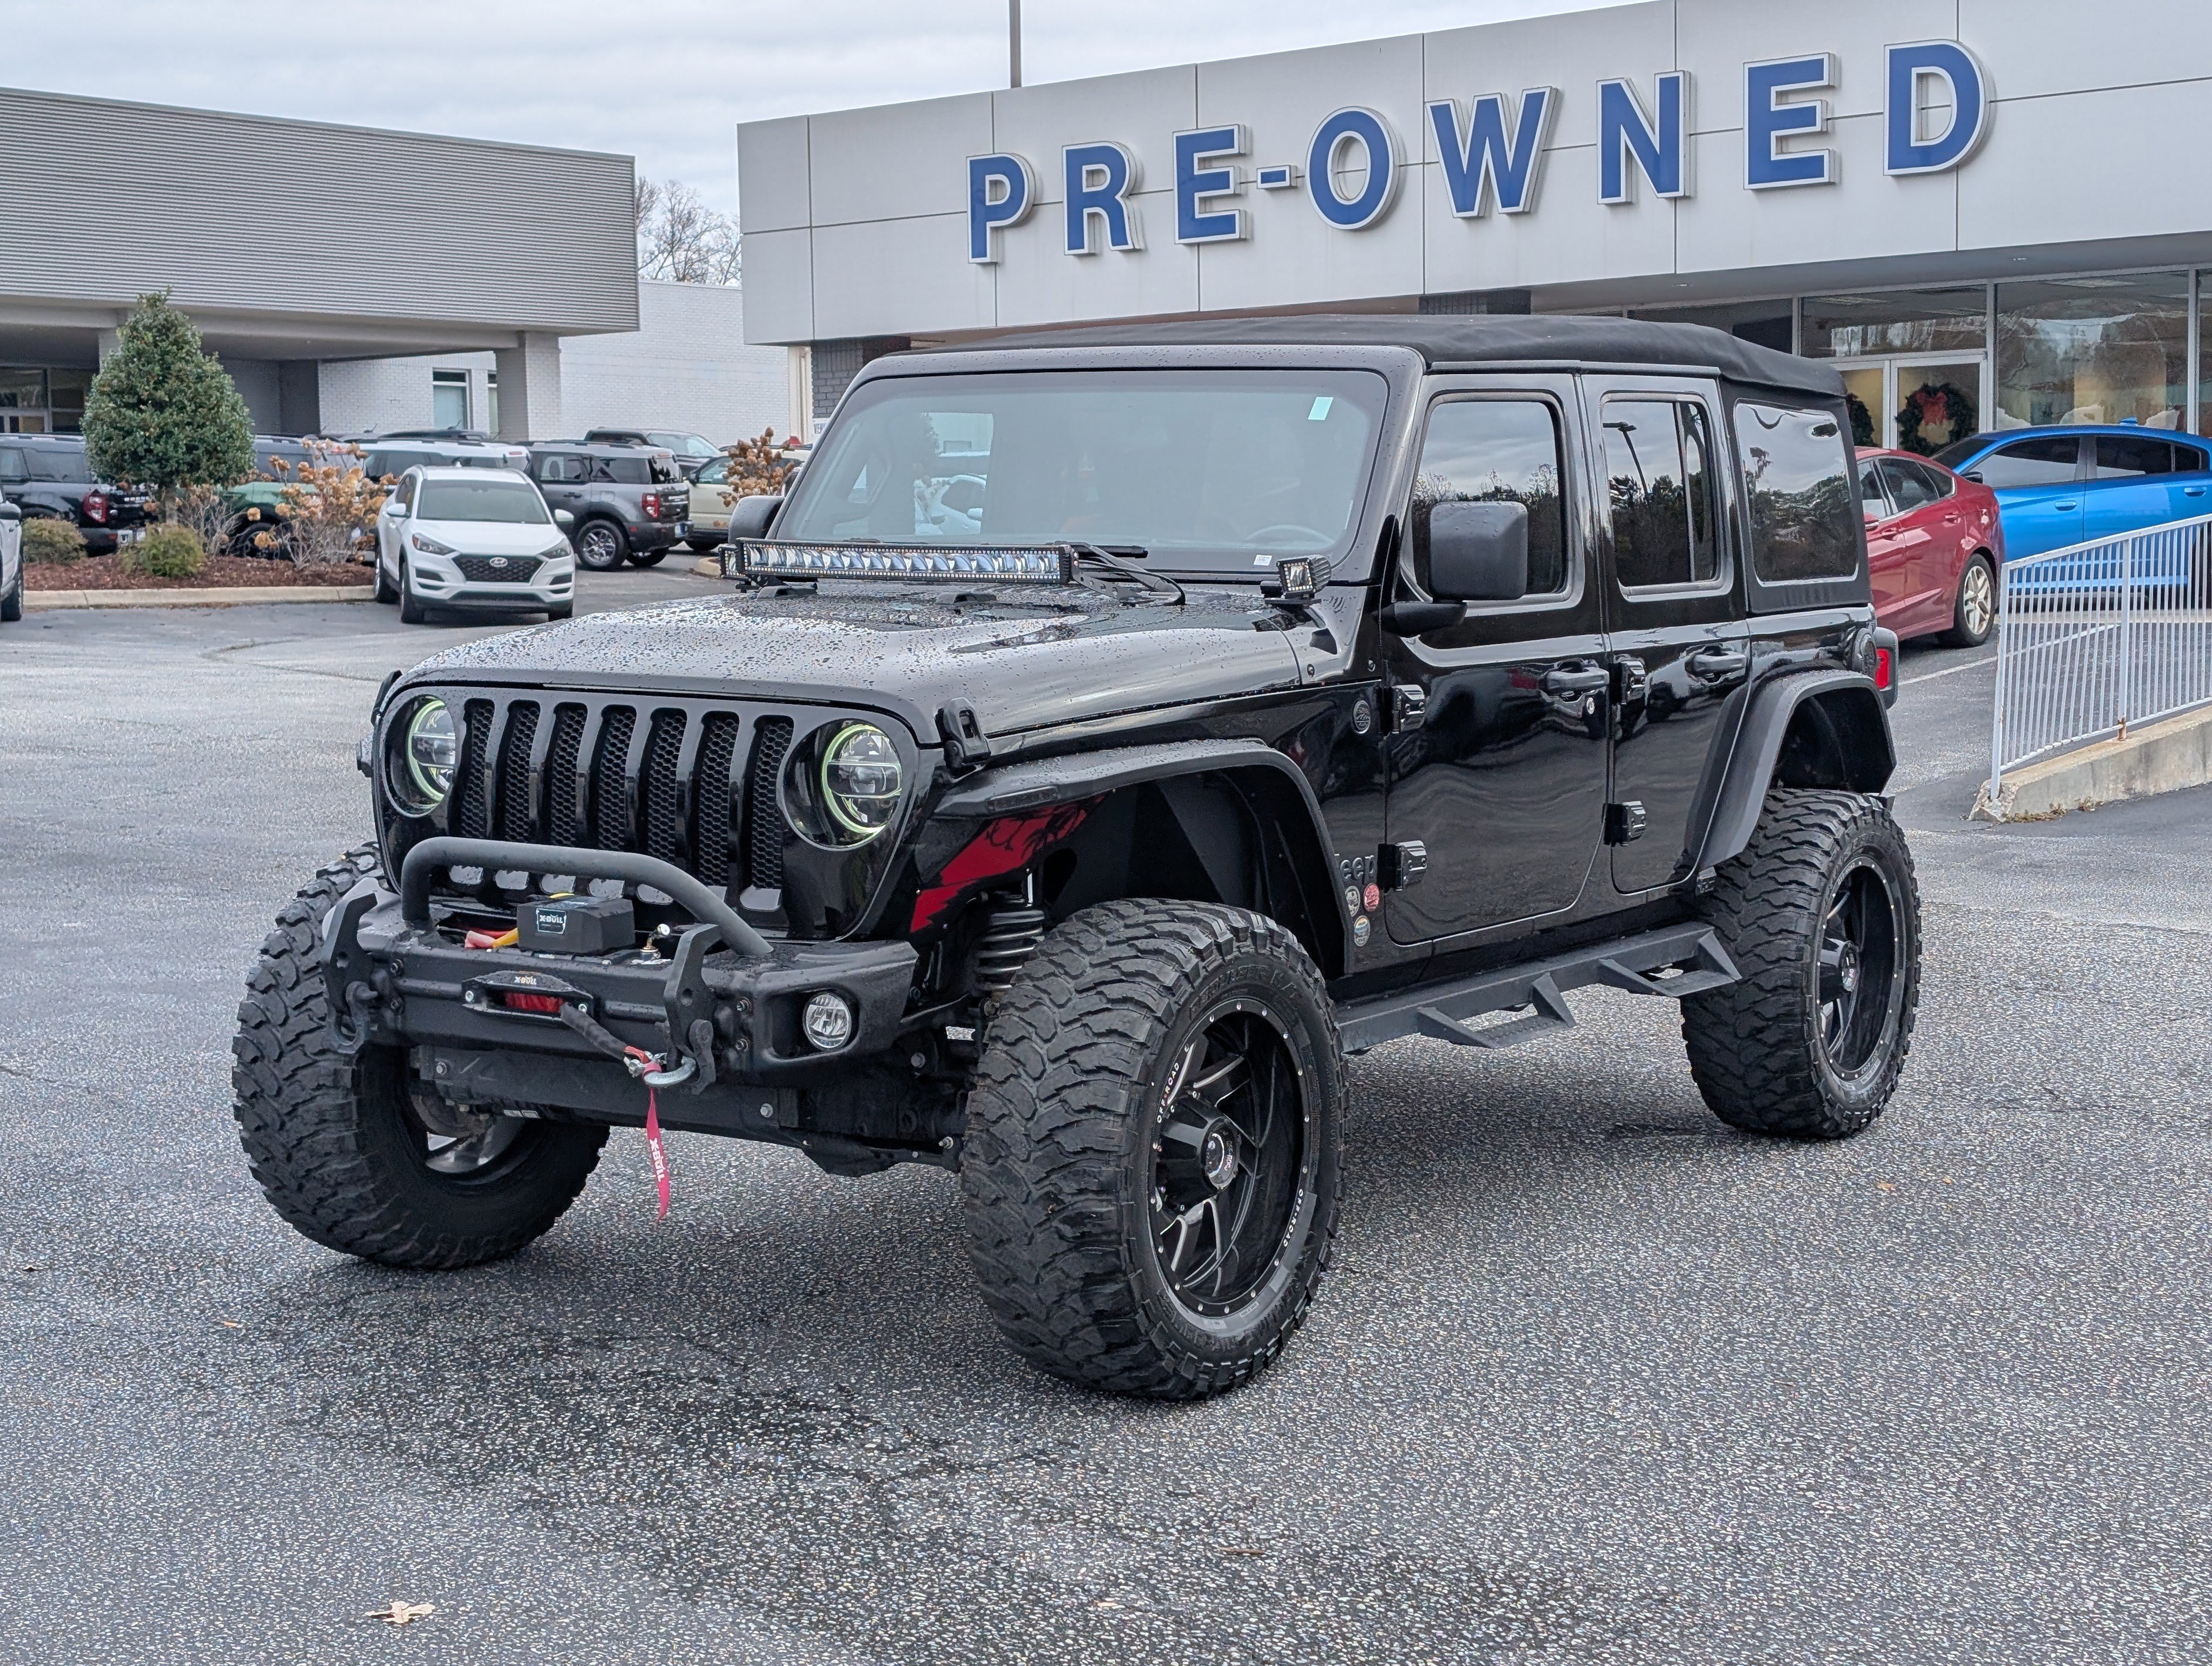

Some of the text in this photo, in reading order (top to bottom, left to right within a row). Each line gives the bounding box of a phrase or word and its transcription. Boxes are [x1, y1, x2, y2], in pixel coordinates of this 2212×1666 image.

[967, 39, 1989, 264] PRE-OWNED
[1334, 854, 1375, 885] eep
[539, 914, 563, 924] X-BULL
[650, 1137, 666, 1182] X-BULL
